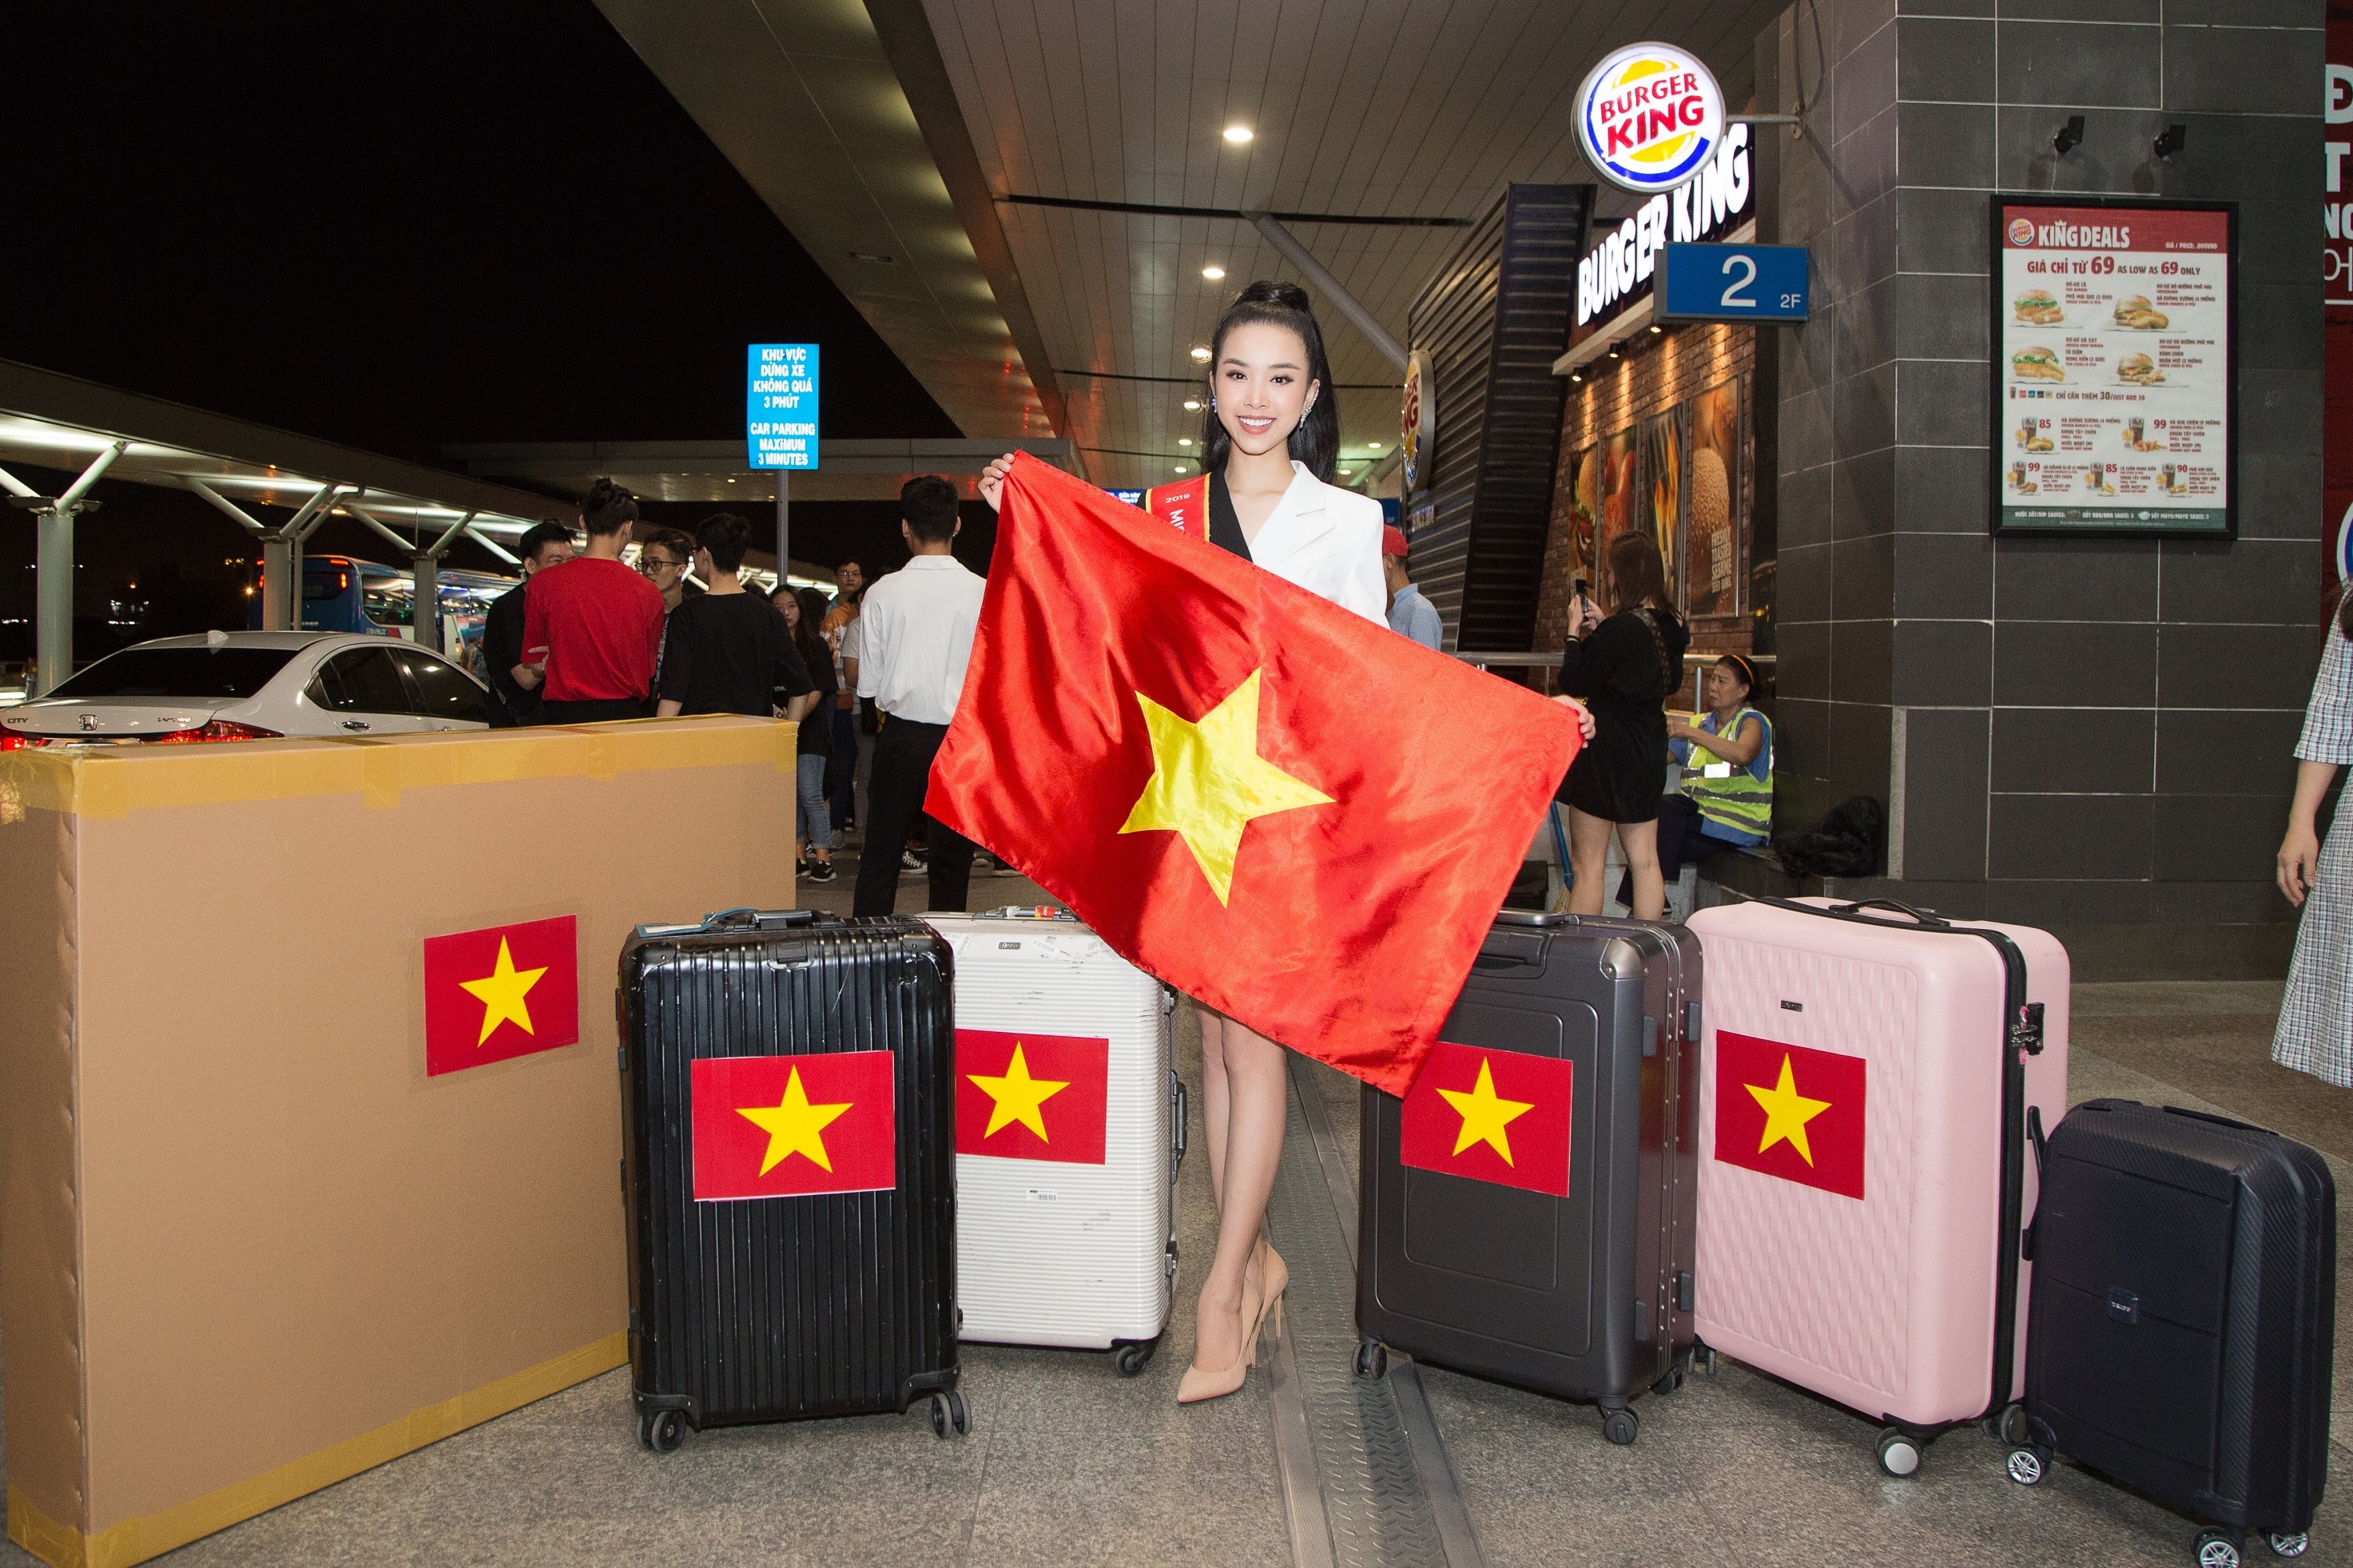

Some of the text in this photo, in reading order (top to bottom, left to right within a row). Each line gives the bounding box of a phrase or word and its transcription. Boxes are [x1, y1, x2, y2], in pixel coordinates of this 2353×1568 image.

[1600, 73, 1699, 125] BURGER
[1608, 94, 1704, 157] KING
[1577, 123, 1750, 327] BURGER KING
[2013, 229, 2032, 240] KING
[2038, 224, 2130, 248] KING DEALS
[2027, 259, 2046, 273] GIÁ
[2050, 257, 2069, 274] CHỈ
[2073, 260, 2088, 274] TỪ
[2091, 256, 2115, 275] 69
[2160, 261, 2179, 275] 69
[1720, 255, 1802, 309] 2 2F
[761, 347, 806, 363] KHU VỰC
[761, 362, 805, 377] DỪNG XE
[753, 377, 813, 394] KHÔNG QUÁ
[764, 393, 800, 408] 3 PHÚT
[2056, 391, 2065, 399] CHỈ
[750, 423, 816, 436] CAR PARKING
[2039, 419, 2051, 428] 85
[2153, 419, 2167, 430] 99
[759, 439, 806, 451] MAXIMUM
[758, 453, 809, 466] 3 MINUTES
[2028, 462, 2041, 472] 99
[2105, 463, 2117, 473] 85
[2177, 464, 2188, 473] 90
[1166, 493, 1190, 504] 2019
